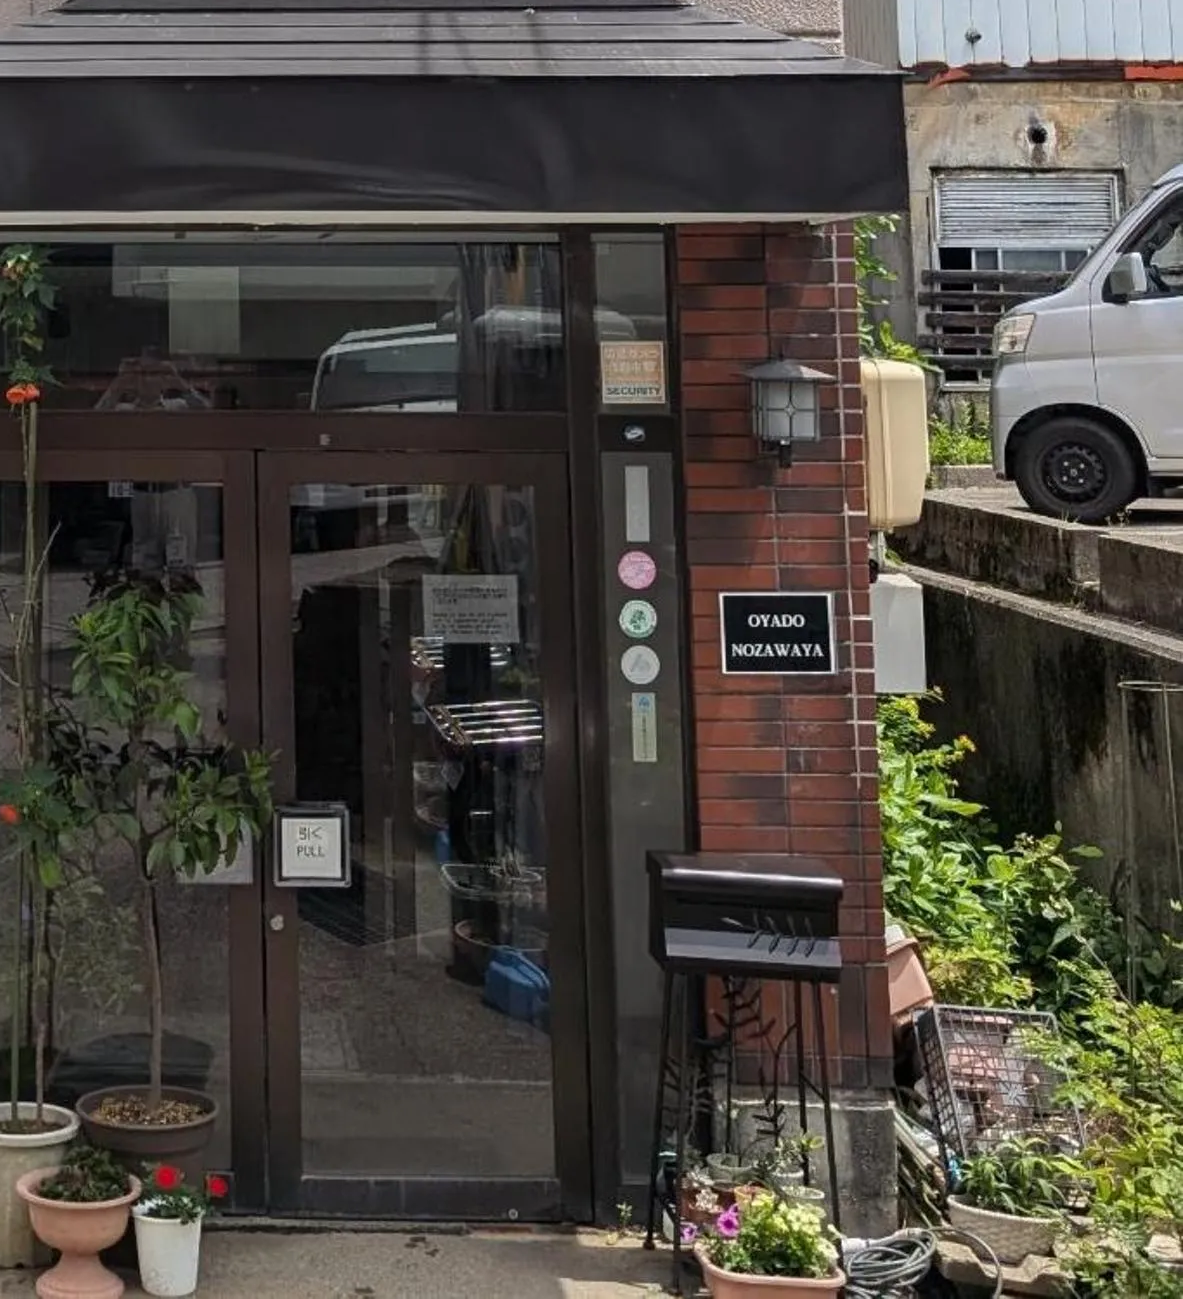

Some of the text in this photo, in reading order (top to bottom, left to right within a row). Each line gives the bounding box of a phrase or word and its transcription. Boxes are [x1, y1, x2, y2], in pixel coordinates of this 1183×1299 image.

[606, 387, 661, 396] SECURITY
[747, 613, 806, 628] OYADO
[731, 643, 824, 657] NOZAWAYA
[296, 845, 326, 858] PULL
